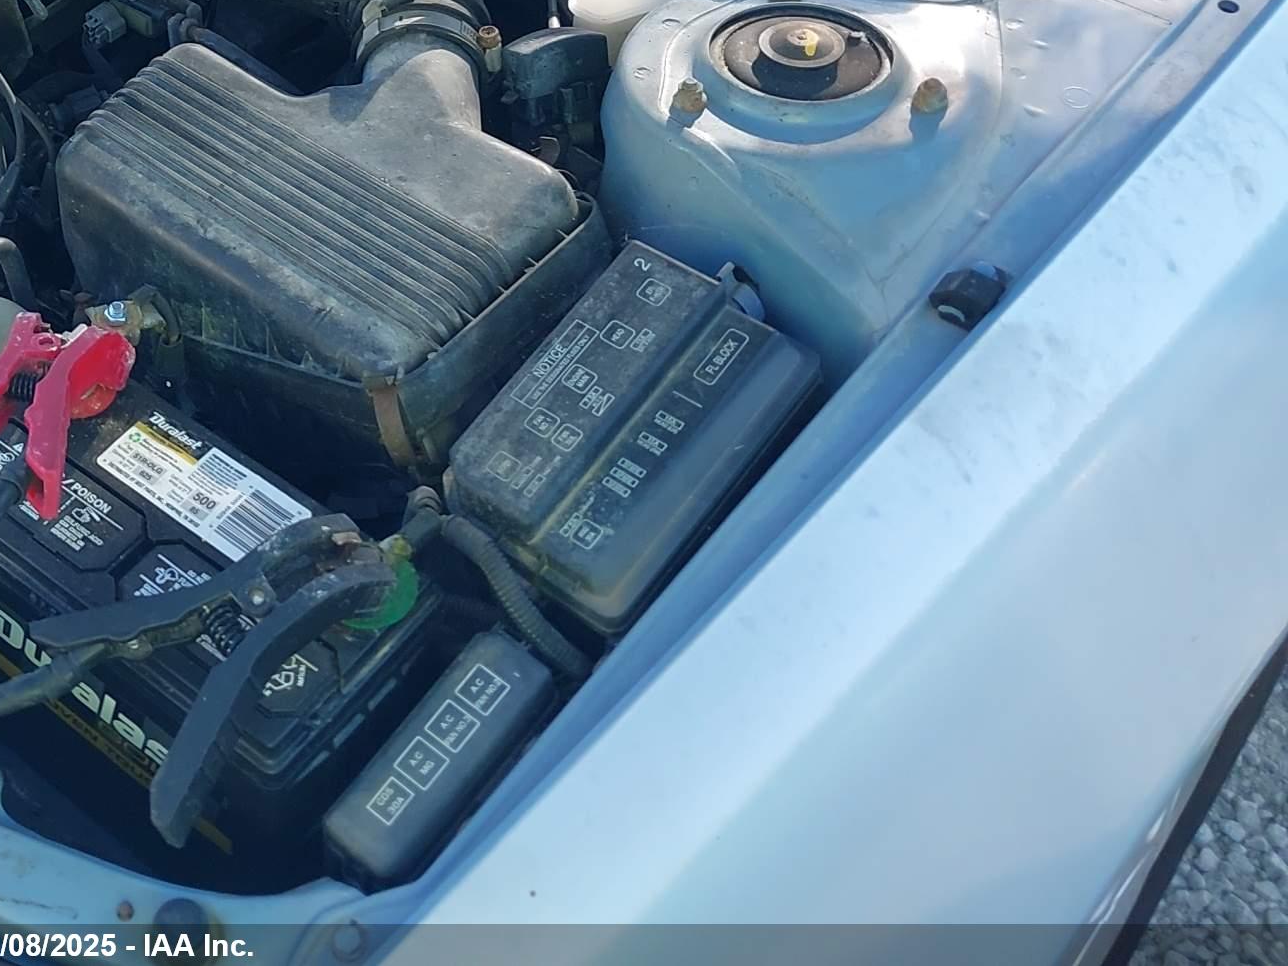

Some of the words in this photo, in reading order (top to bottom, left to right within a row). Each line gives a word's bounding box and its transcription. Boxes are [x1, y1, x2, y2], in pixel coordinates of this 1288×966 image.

[533, 344, 568, 378] NOTICE
[713, 338, 739, 366] BLOCK
[149, 411, 203, 450] Duralast
[70, 483, 112, 514] POISON
[192, 491, 218, 511] 500
